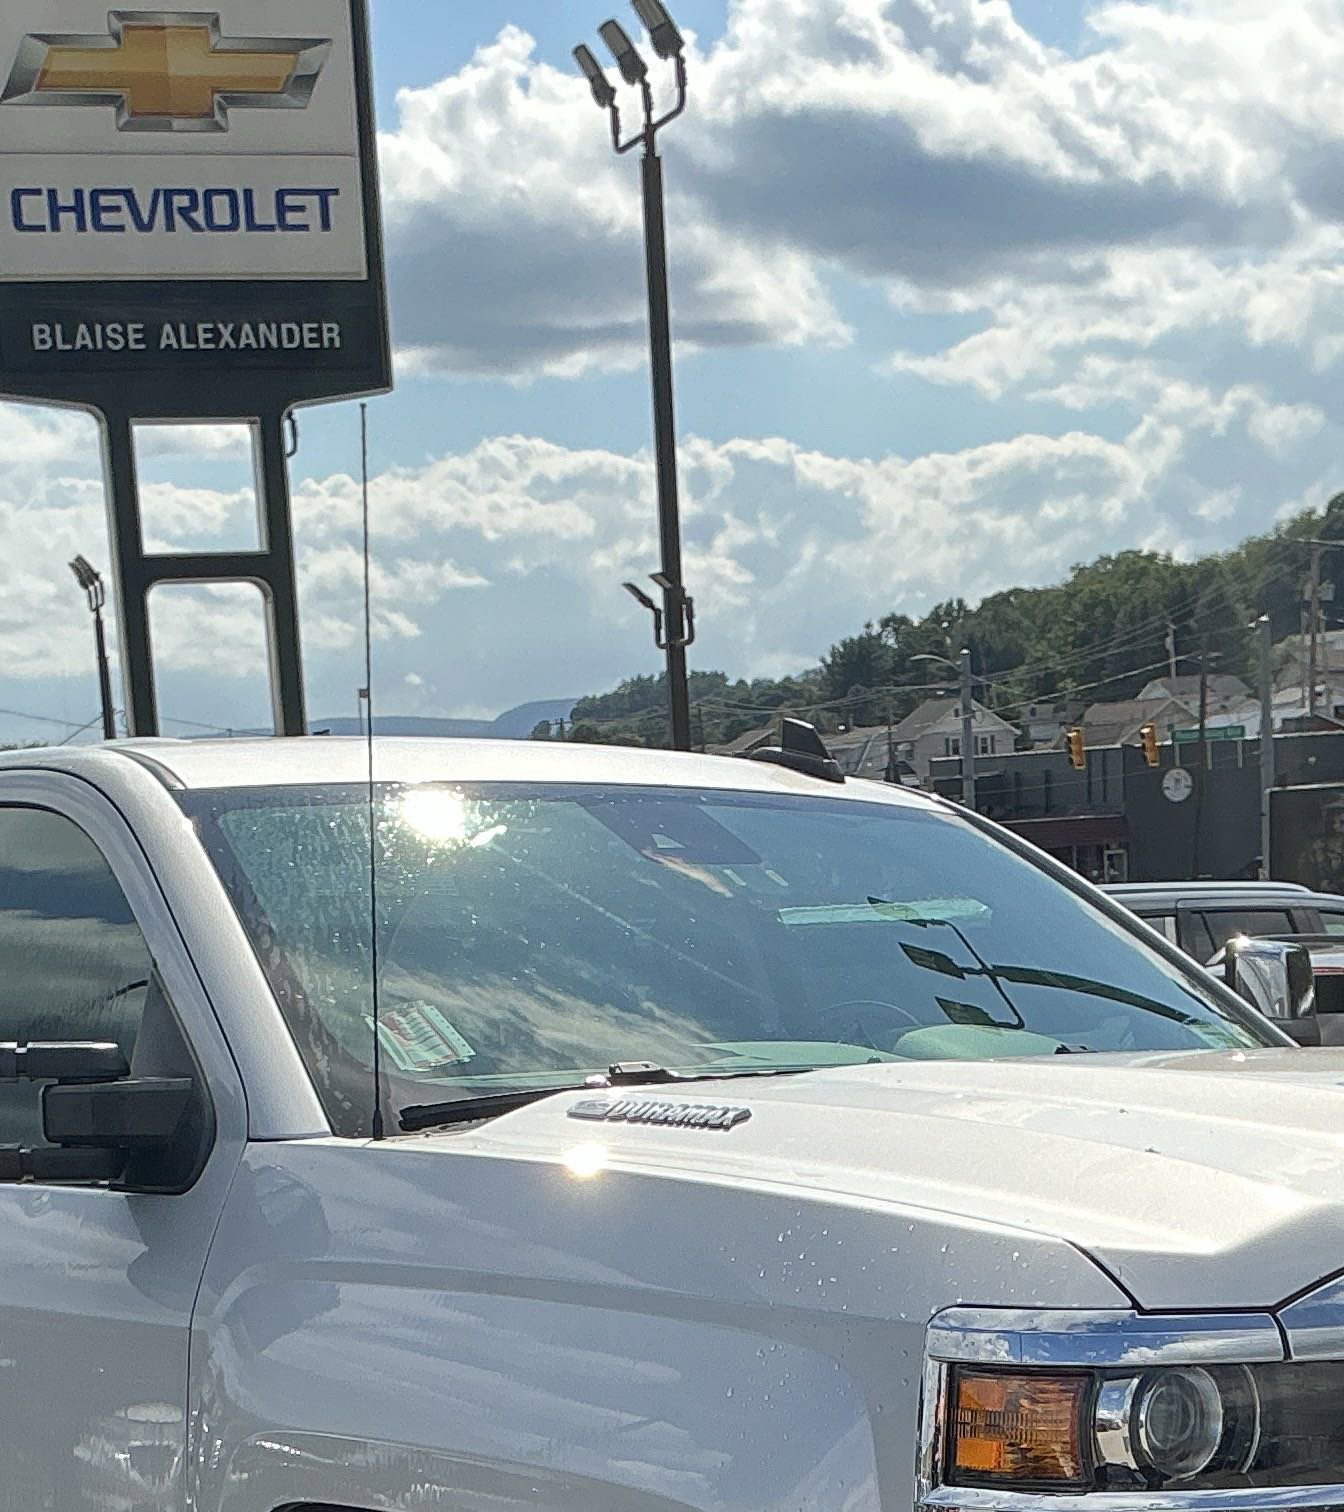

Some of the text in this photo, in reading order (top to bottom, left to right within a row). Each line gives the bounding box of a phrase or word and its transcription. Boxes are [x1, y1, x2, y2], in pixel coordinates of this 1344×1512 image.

[11, 188, 340, 232] CHEVROLET
[32, 323, 341, 351] BLAISE ALEXANDER
[607, 1100, 752, 1131] DURAMAX
